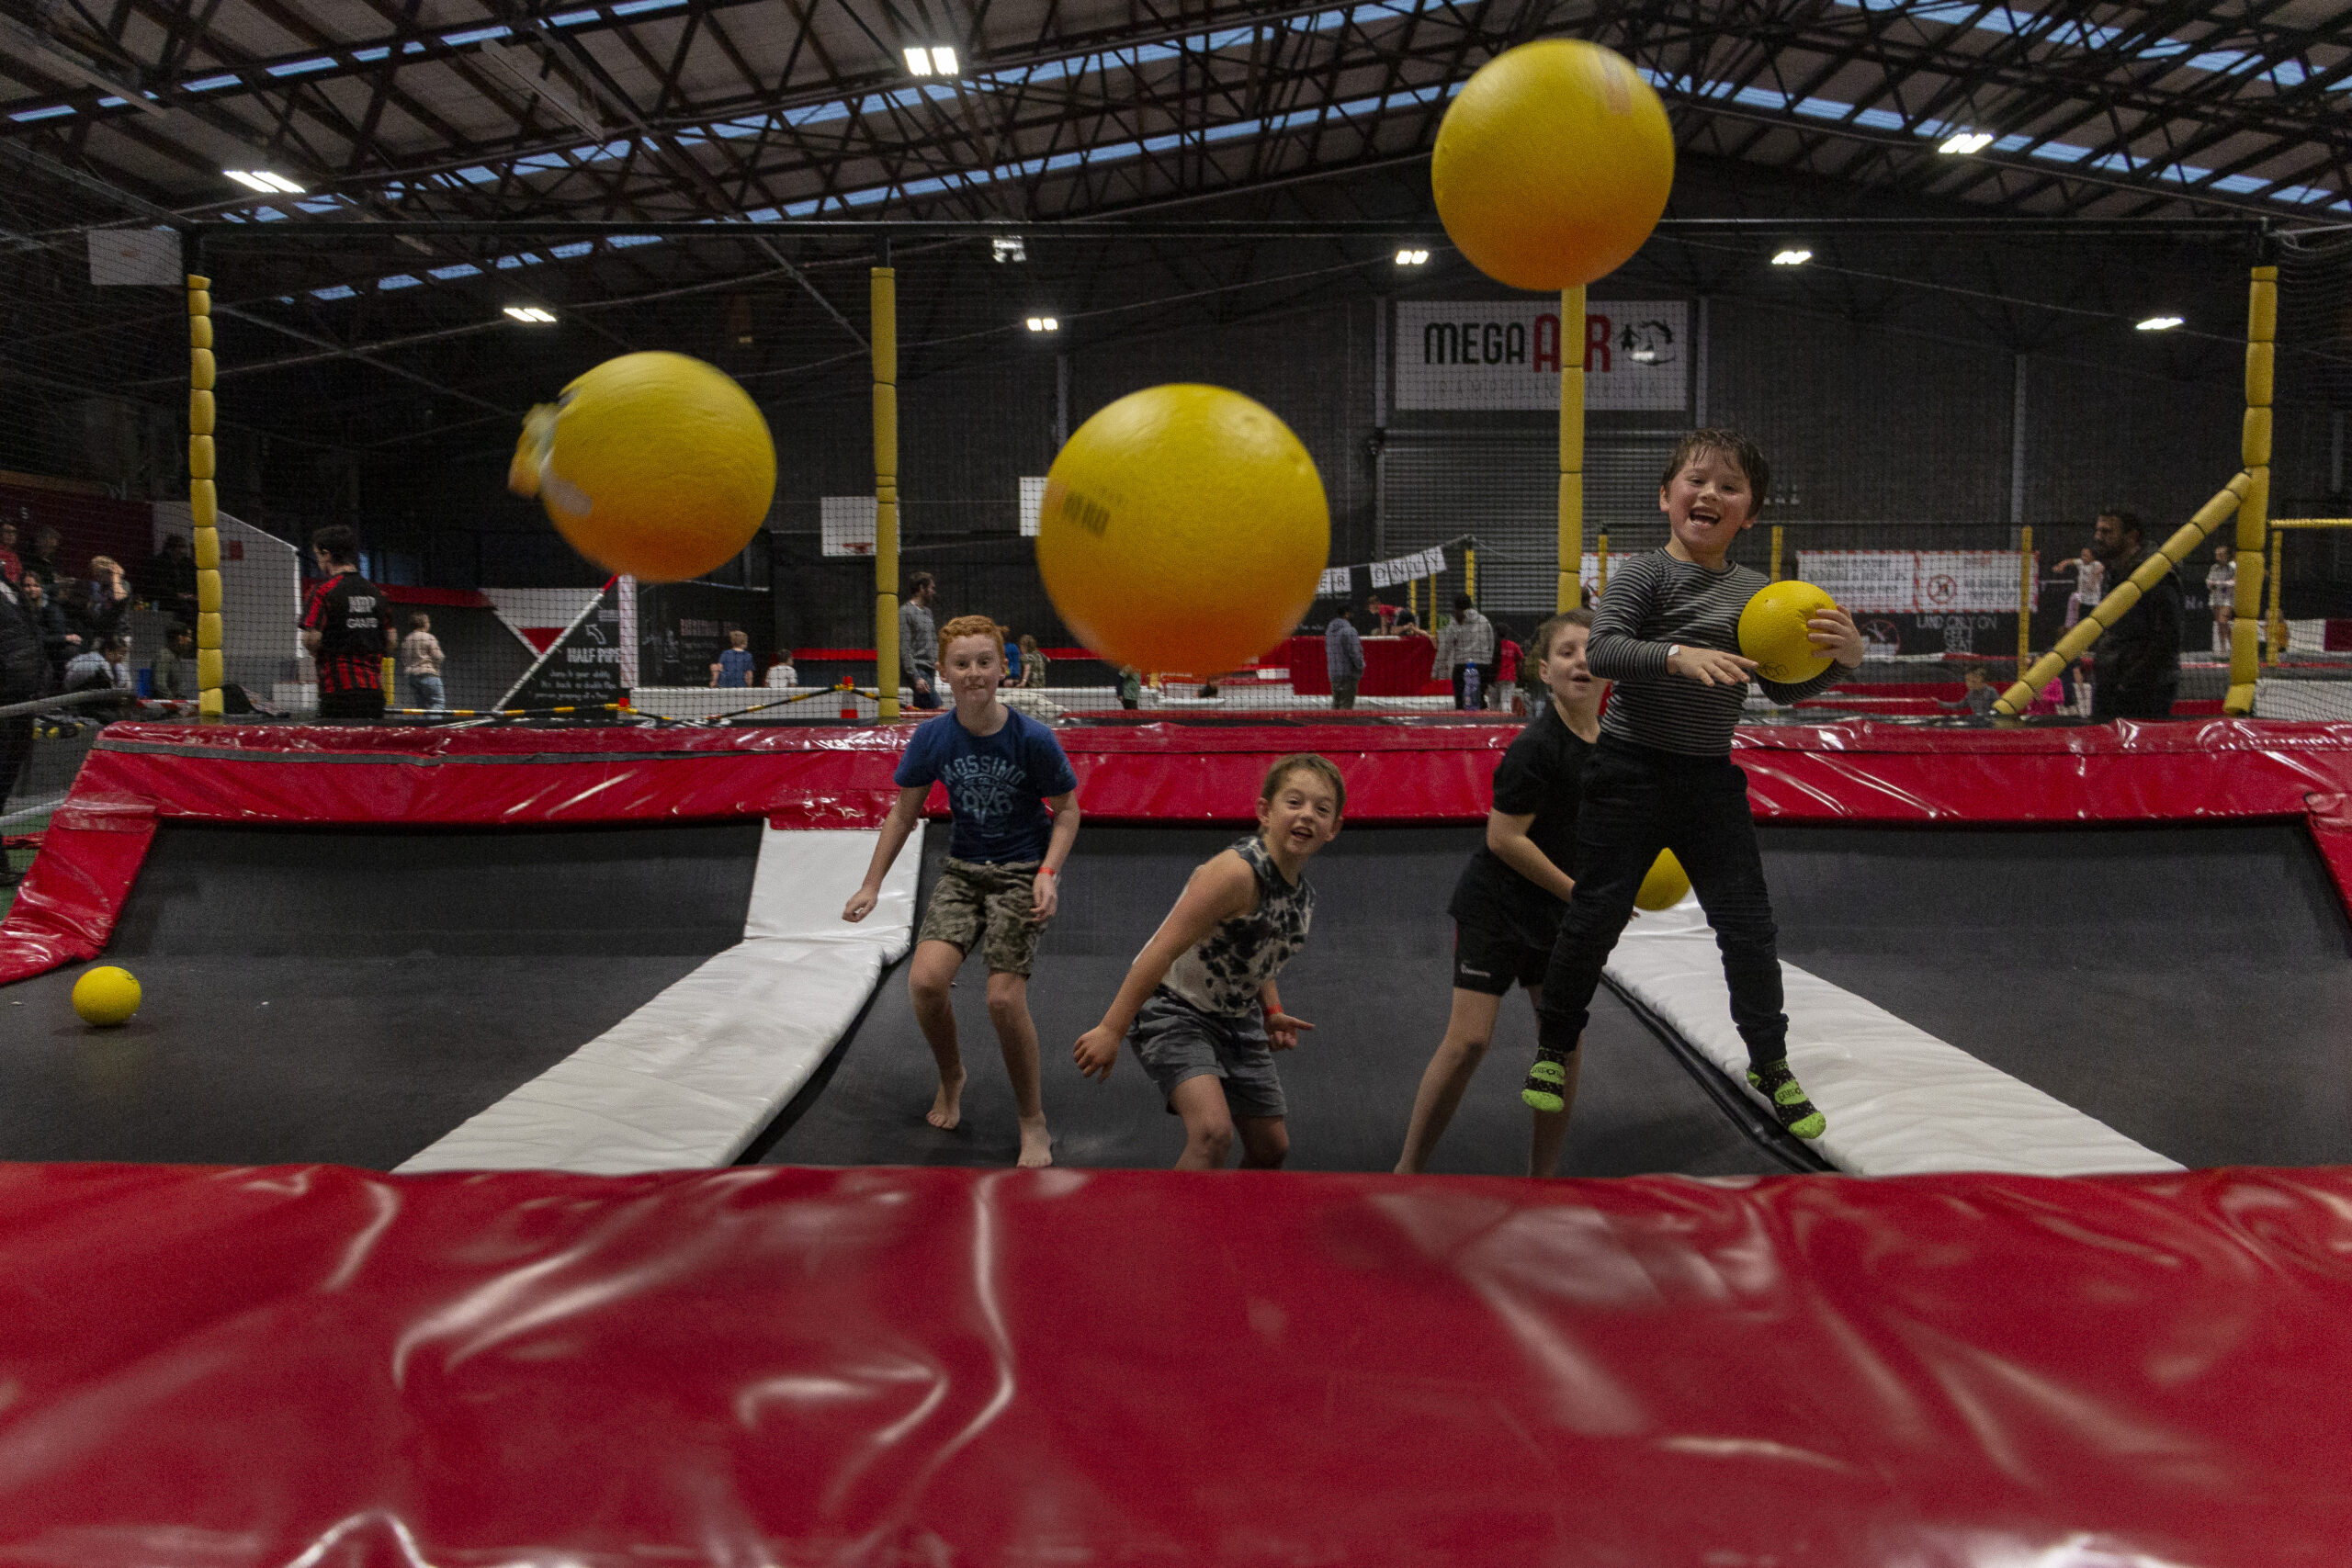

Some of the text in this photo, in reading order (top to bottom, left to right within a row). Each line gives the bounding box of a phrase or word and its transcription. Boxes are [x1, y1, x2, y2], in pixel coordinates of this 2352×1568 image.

[1424, 312, 1611, 373] MEGA AR
[1374, 554, 1440, 581] ONLY
[1977, 615, 1997, 629] ON
[566, 648, 596, 664] HALF
[941, 753, 1027, 786] MOSSIMO
